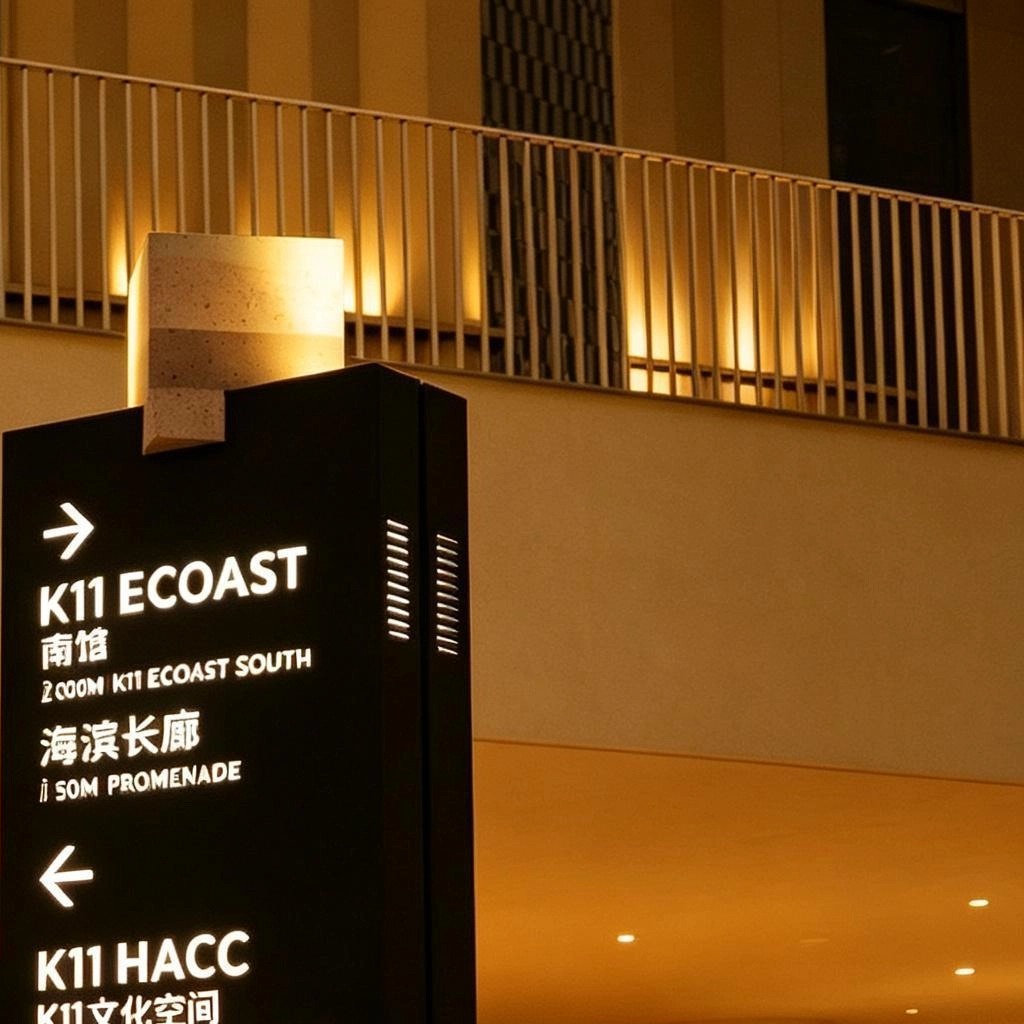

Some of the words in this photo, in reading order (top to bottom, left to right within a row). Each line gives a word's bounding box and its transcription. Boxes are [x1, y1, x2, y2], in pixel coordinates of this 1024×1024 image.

[39, 576, 104, 628] K11
[119, 545, 308, 616] ECOAST
[112, 669, 143, 694] K11
[146, 657, 231, 689] ECOAST
[234, 647, 312, 678] SOUTH
[39, 708, 201, 768] 海滨长廊
[107, 760, 243, 796] PROMENADE
[37, 944, 102, 992] K11
[116, 930, 250, 985] HACC
